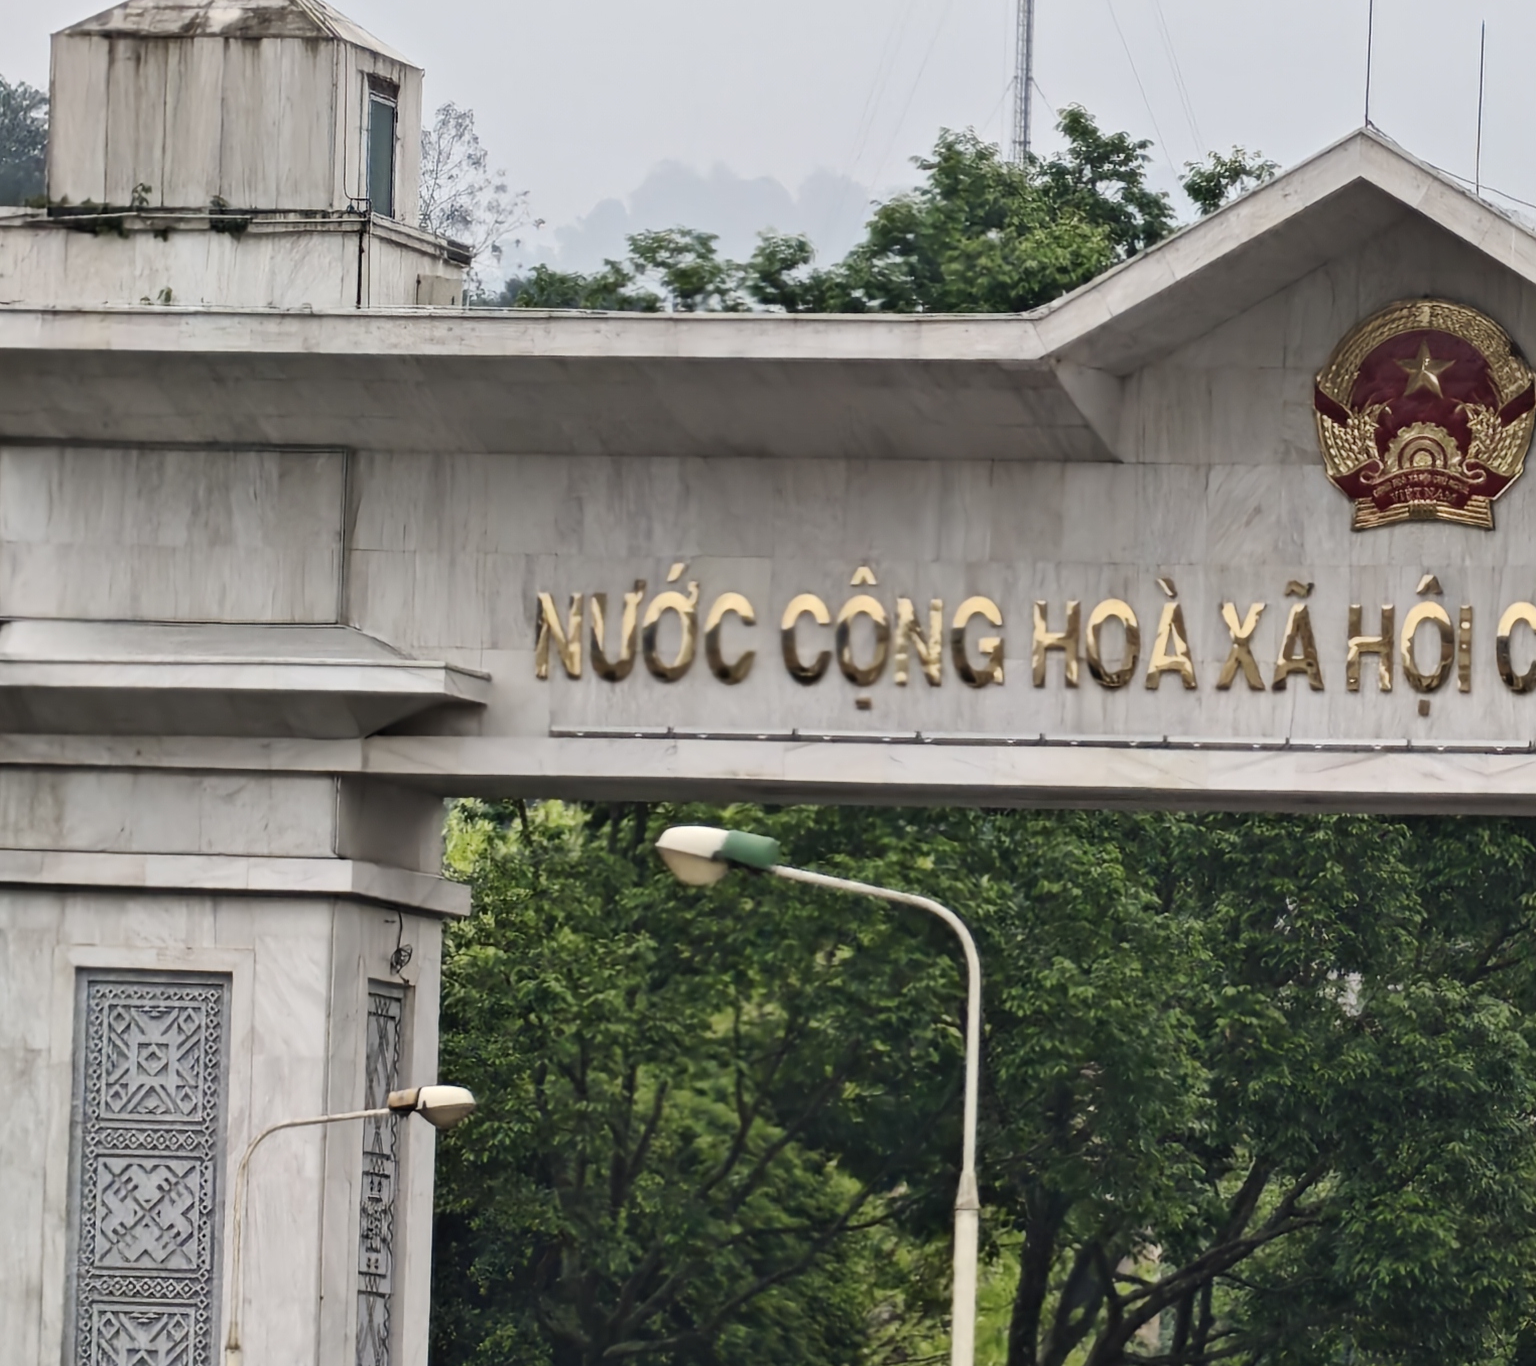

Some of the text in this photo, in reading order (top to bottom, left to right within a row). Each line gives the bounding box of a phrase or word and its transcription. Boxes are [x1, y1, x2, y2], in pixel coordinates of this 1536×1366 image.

[534, 562, 756, 685] NƯỚC
[781, 566, 1005, 710] CỘNG
[1031, 577, 1198, 692] HOÀ
[1215, 579, 1324, 692] XÃ
[1346, 573, 1472, 718] HỘI
